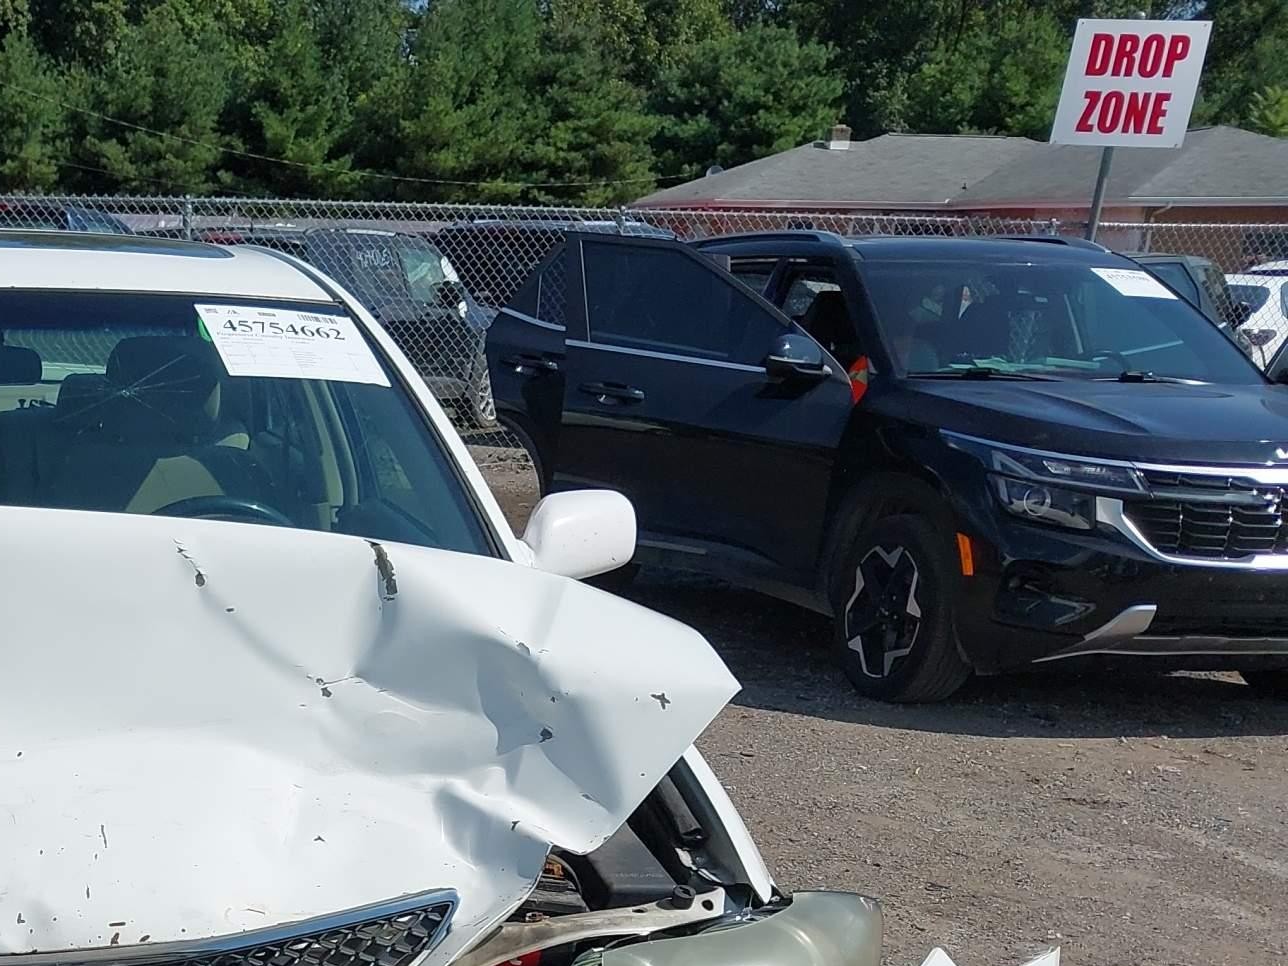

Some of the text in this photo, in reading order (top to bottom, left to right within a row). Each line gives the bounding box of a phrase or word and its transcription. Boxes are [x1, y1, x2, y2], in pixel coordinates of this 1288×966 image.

[1085, 33, 1191, 78] DROP
[1075, 91, 1172, 135] ZONE
[223, 319, 346, 341] 45754662
